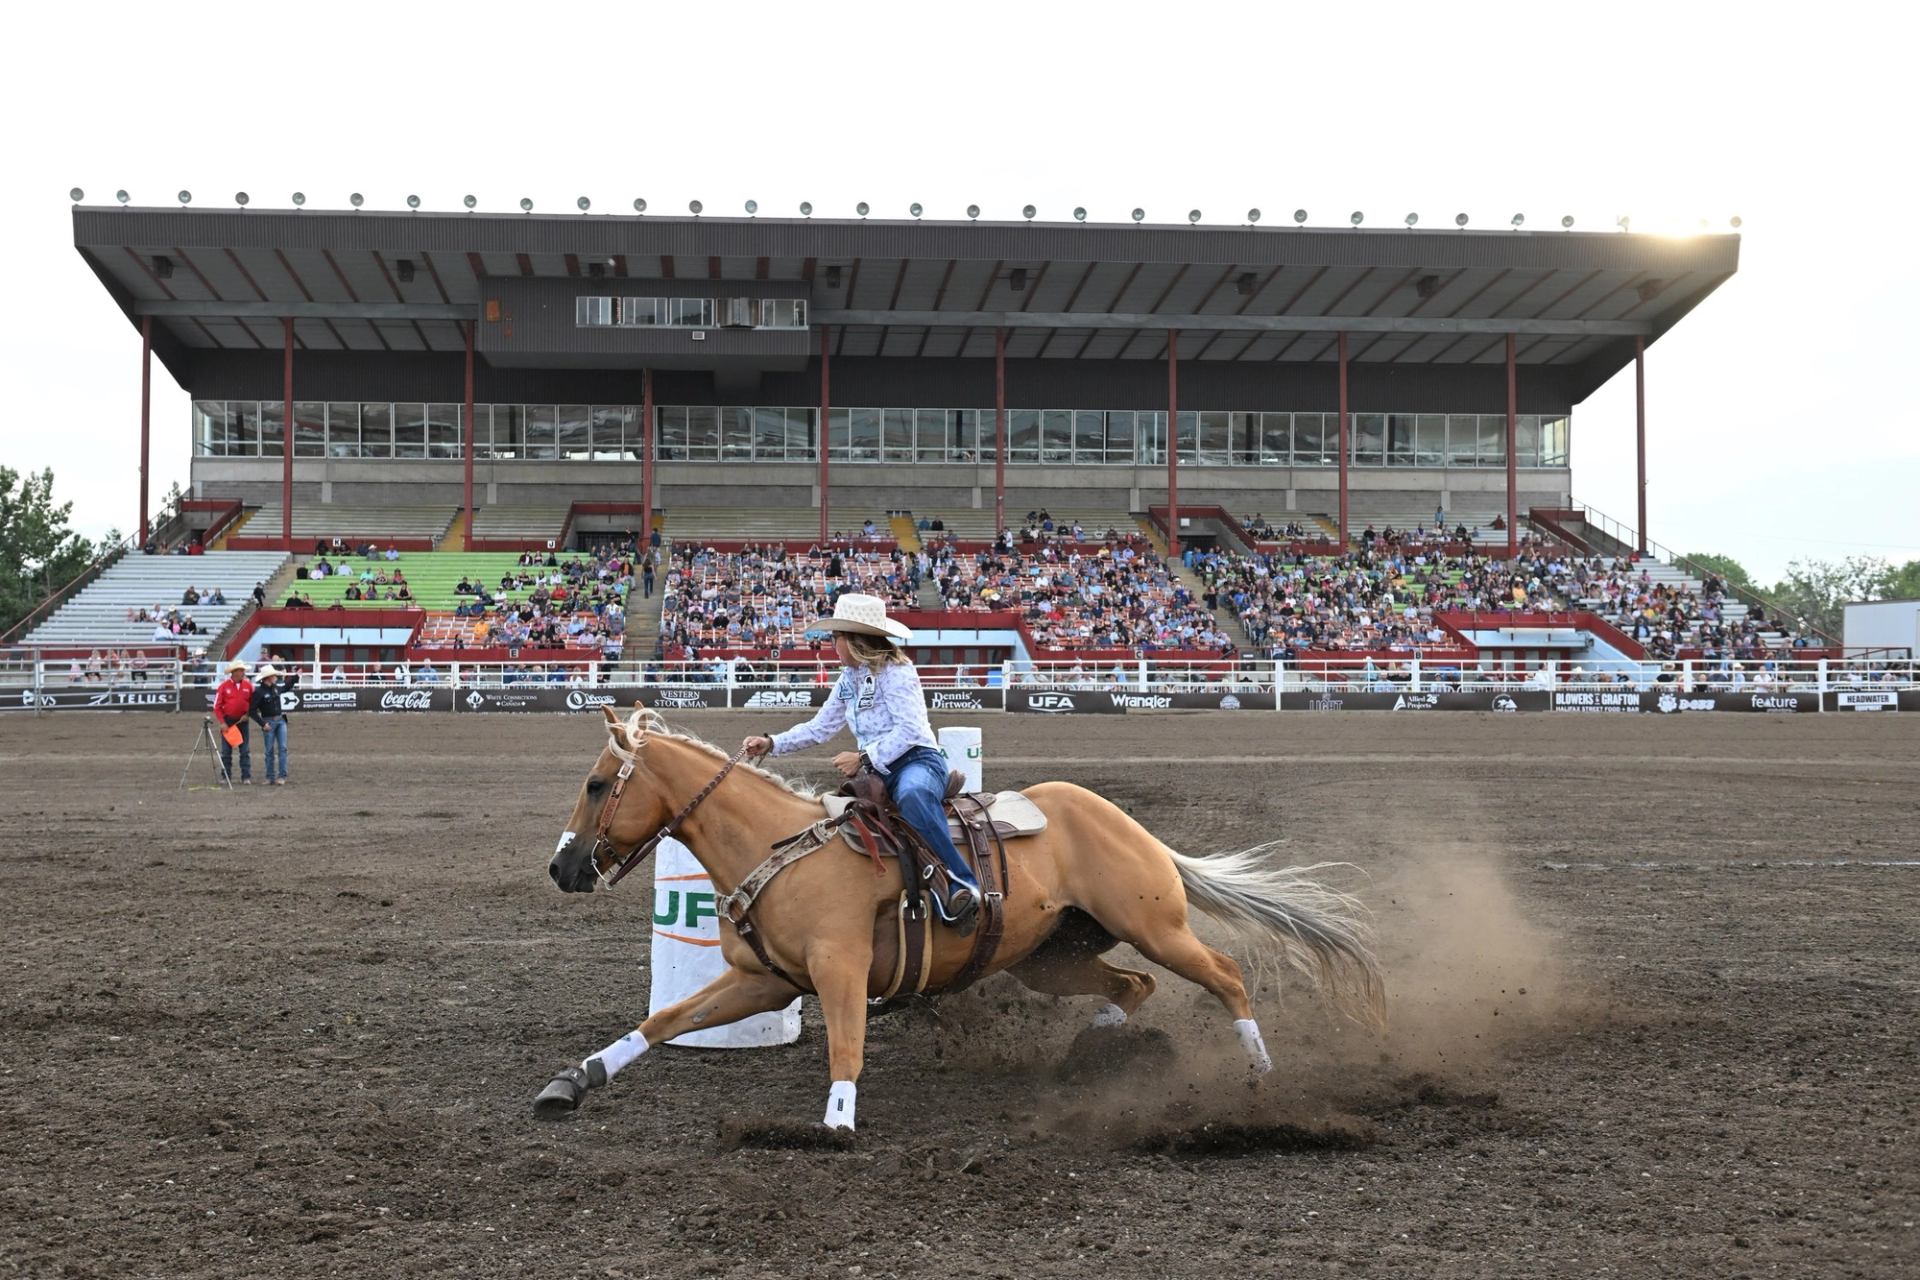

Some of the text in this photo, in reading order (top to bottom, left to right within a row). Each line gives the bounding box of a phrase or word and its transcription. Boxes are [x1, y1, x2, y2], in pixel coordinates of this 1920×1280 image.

[118, 693, 168, 704] TELUS
[303, 692, 357, 701] COOPER
[381, 690, 432, 709] Coca-Cola
[660, 689, 700, 699] WESTERN
[760, 691, 812, 703] SMS
[1555, 693, 1594, 705] BLOWERS
[1601, 693, 1640, 705] GRAFTON
[1846, 695, 1890, 703] HEADWATER
[654, 699, 708, 709] STOCKMAN
[1028, 696, 1075, 708] UFA
[1110, 693, 1172, 709] Wrangler
[1407, 701, 1432, 709] Projects
